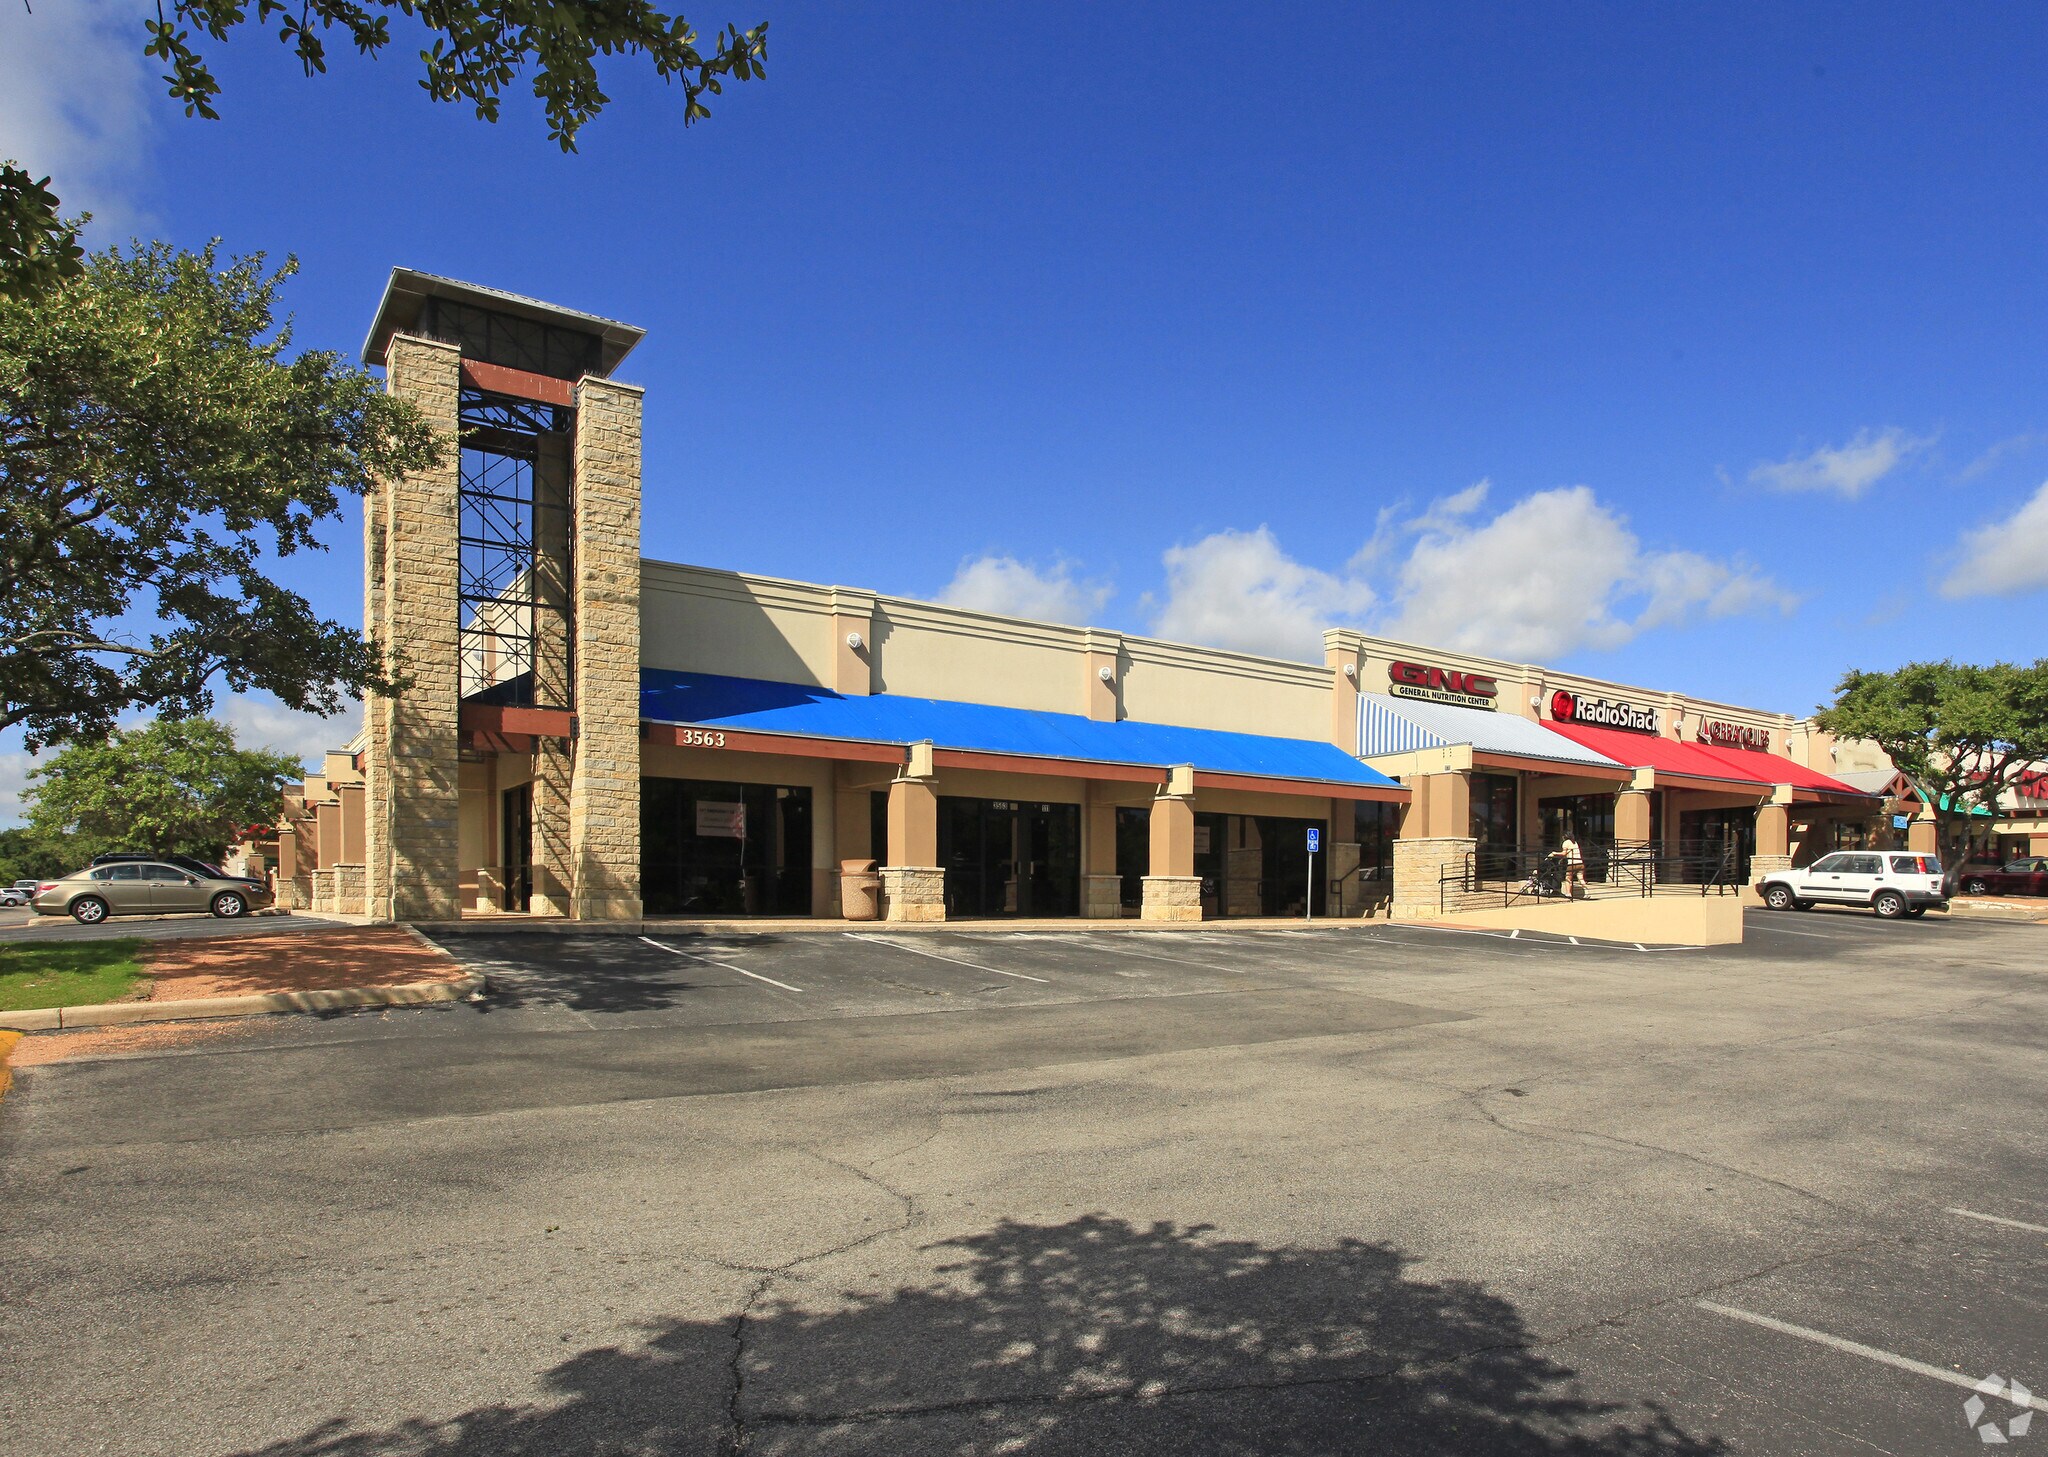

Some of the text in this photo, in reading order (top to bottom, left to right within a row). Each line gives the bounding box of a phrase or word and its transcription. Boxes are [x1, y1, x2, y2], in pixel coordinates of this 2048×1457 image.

[1389, 661, 1497, 697] GNC
[1399, 686, 1490, 706] GENERAL NUTRITION CENTER
[1575, 696, 1661, 732] RadioShack
[683, 729, 725, 747] 3563
